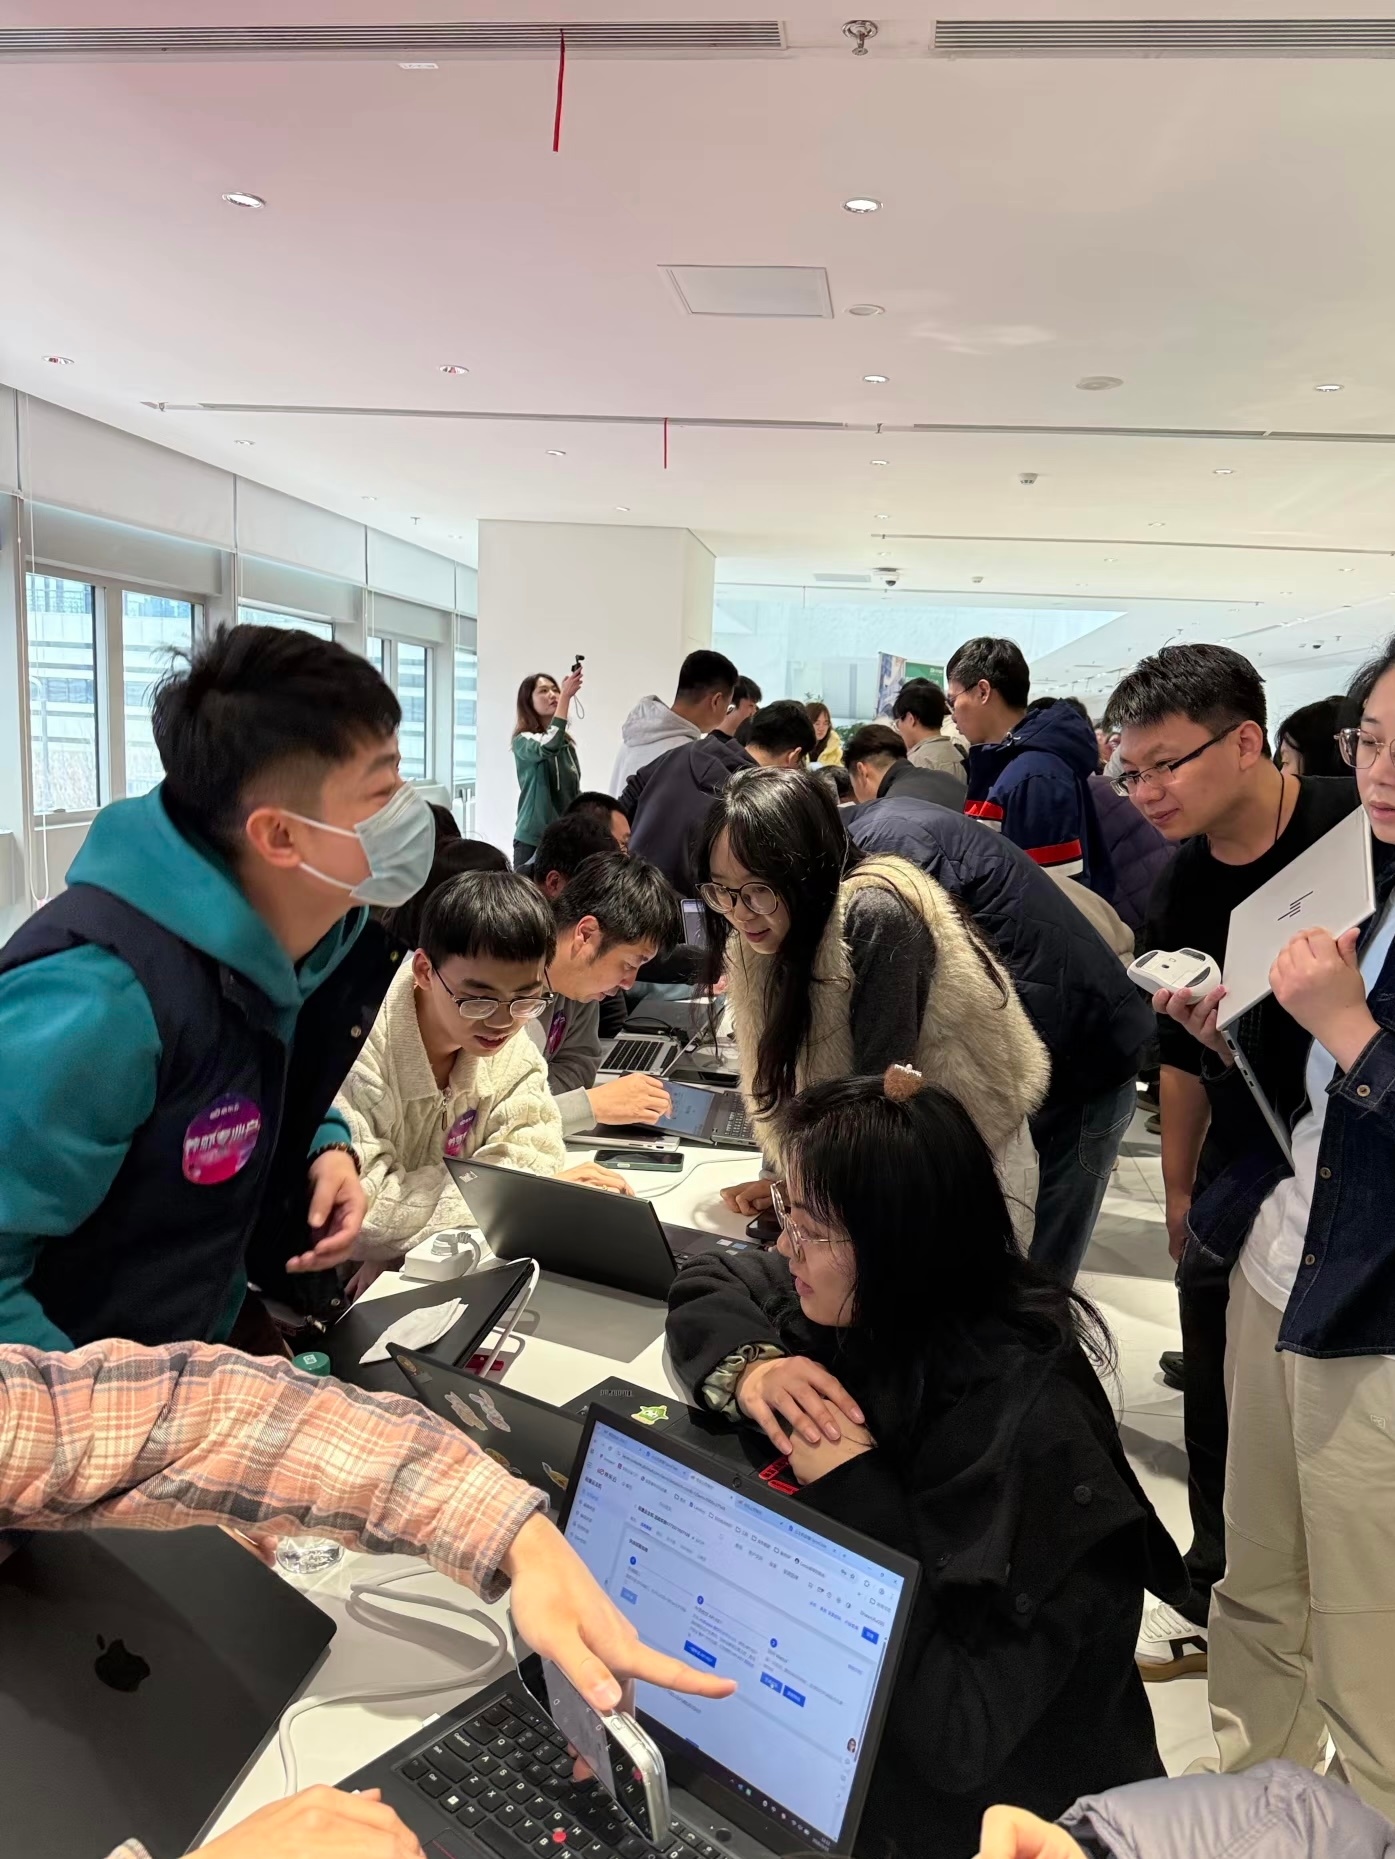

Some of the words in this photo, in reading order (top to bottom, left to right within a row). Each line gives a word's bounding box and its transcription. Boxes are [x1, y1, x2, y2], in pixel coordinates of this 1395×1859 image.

[482, 1755, 490, 1763] A
[470, 1776, 479, 1784] Z
[516, 1782, 525, 1790] D
[488, 1790, 496, 1798] X
[505, 1804, 514, 1812] C
[554, 1812, 562, 1820] G
[524, 1819, 533, 1827] V
[572, 1826, 582, 1835] H
[539, 1837, 548, 1846] B
